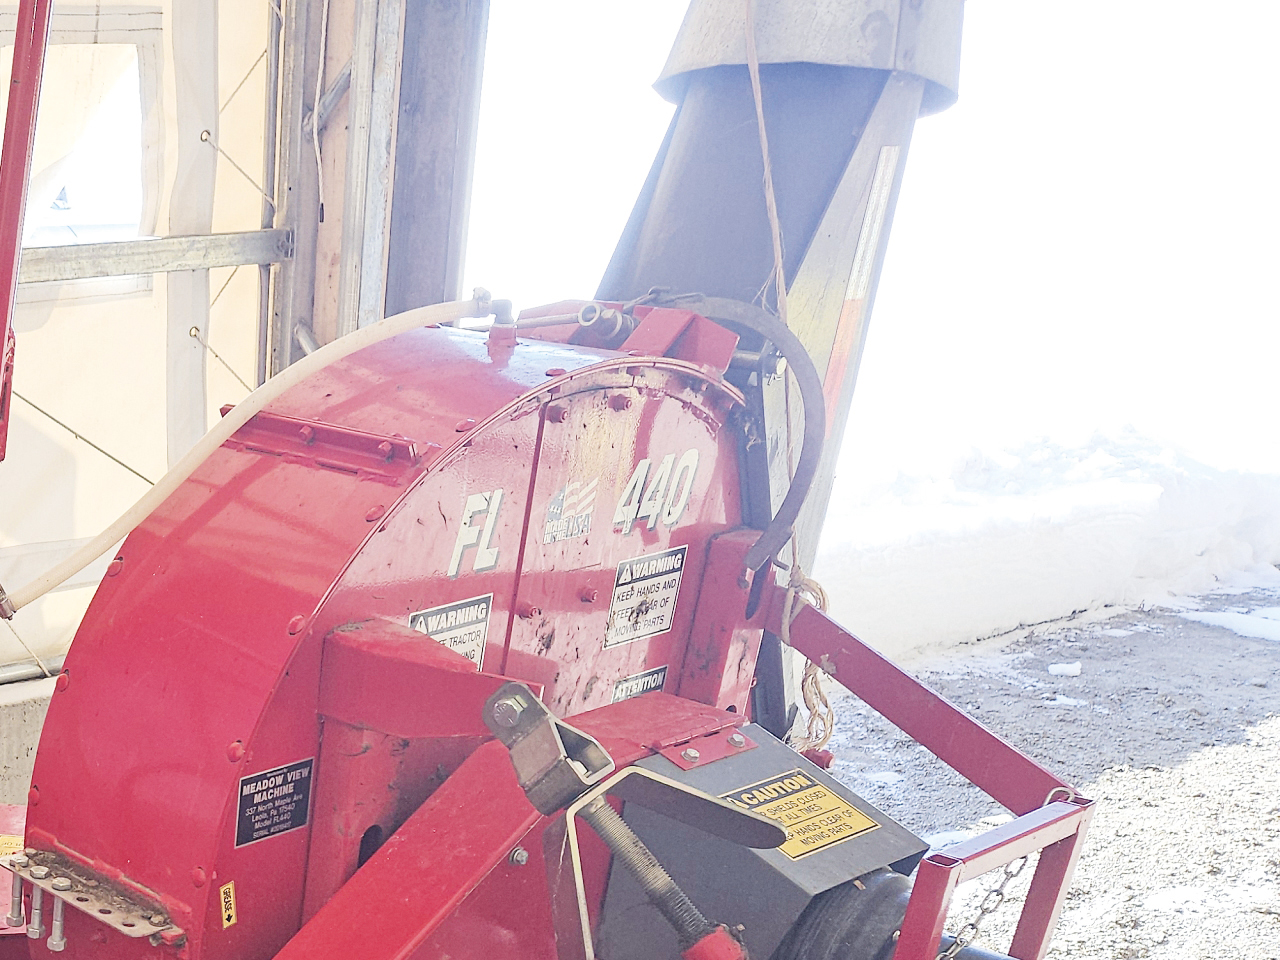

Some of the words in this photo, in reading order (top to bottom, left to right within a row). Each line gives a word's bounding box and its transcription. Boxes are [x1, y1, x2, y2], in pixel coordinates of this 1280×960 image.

[447, 488, 503, 578] FL
[612, 448, 699, 534] 440
[633, 553, 682, 579] WARNING
[616, 588, 634, 603] KEEP
[636, 582, 660, 598] HANDS
[662, 579, 676, 591] AND
[660, 597, 670, 608] OF
[427, 602, 487, 633] WARNING
[643, 615, 664, 629] PARTS
[449, 630, 481, 647] TRACTOR
[614, 671, 665, 700] ATTENTION
[242, 774, 284, 796] MEADOW
[287, 767, 310, 783] VIEW
[254, 783, 294, 804] MACHINE
[741, 774, 813, 805] CAUTION
[766, 800, 798, 816] SHIELDS
[796, 790, 827, 805] CLOSED
[785, 811, 801, 821] ALL
[799, 803, 823, 816] TIMES
[794, 822, 822, 837] HANDS
[818, 813, 841, 827] CLEAR
[841, 809, 854, 818] OF
[800, 831, 831, 846] MOVING
[828, 822, 853, 836] PARTS
